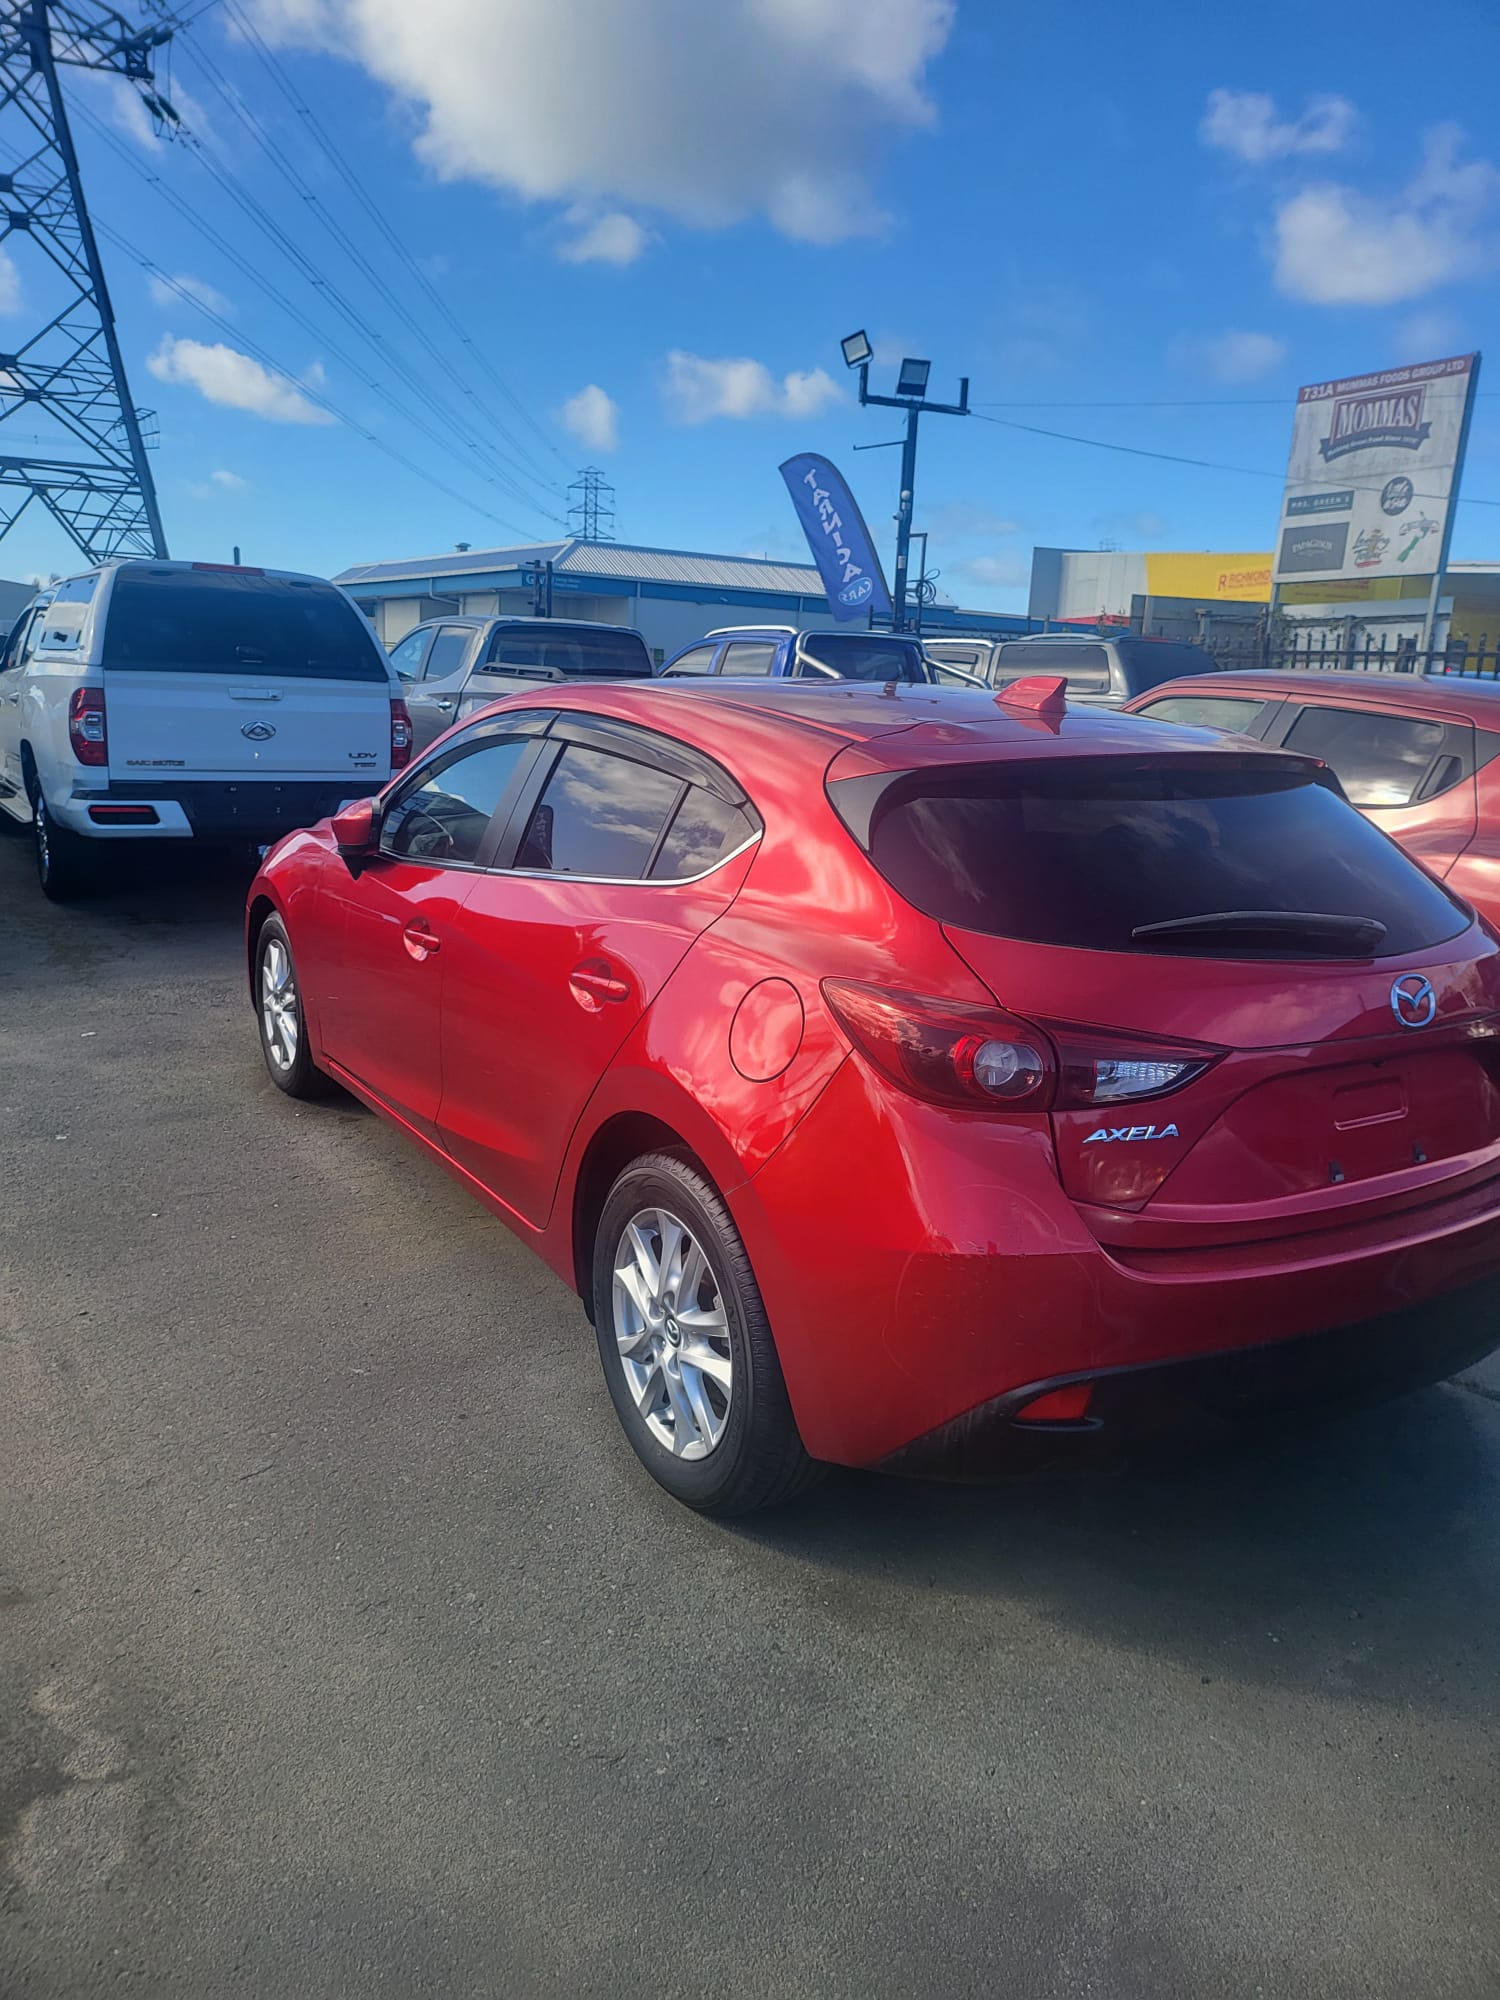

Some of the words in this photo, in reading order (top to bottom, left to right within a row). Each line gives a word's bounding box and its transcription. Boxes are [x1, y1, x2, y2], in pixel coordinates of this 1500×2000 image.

[1303, 384, 1335, 400] 731A
[1336, 375, 1379, 393] MOMMAS
[1412, 363, 1447, 379] GROUP
[1447, 359, 1465, 372] LTD
[1082, 1123, 1179, 1143] AXELA
